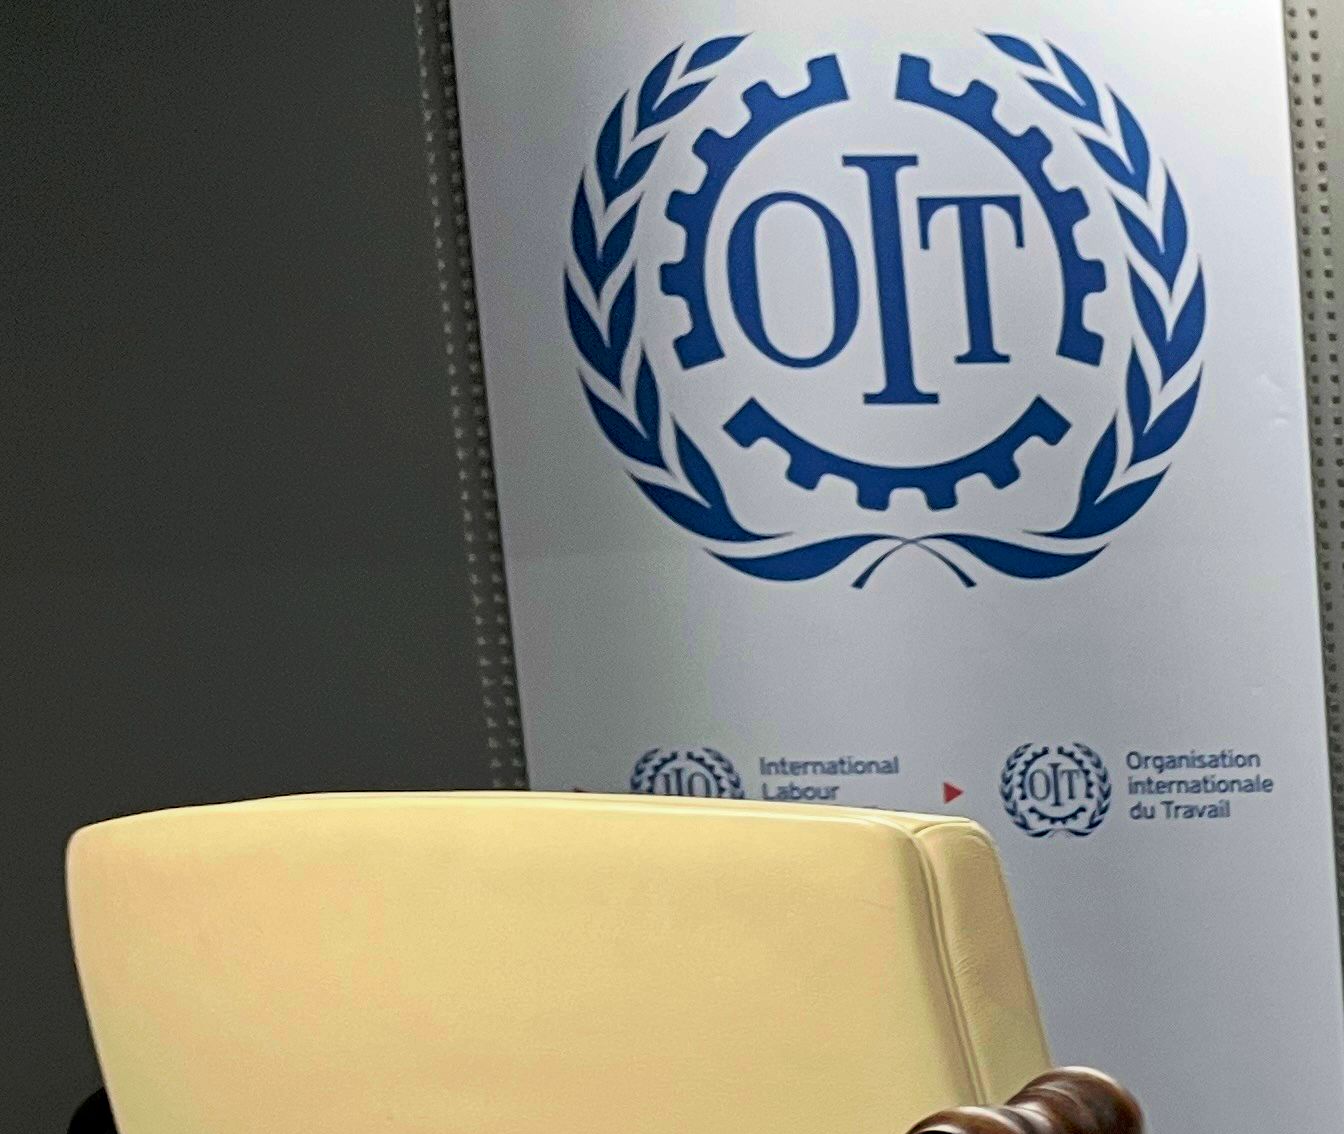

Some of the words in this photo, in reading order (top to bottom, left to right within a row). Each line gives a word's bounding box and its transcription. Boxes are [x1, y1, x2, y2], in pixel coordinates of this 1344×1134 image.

[726, 154, 1025, 405] OIT
[759, 755, 900, 776] International
[1125, 749, 1262, 774] Organisation
[761, 781, 840, 801] Labour
[1029, 762, 1081, 807] OIT
[1127, 774, 1275, 796] internationale
[1129, 801, 1156, 820] du
[1160, 799, 1232, 820] Travail
